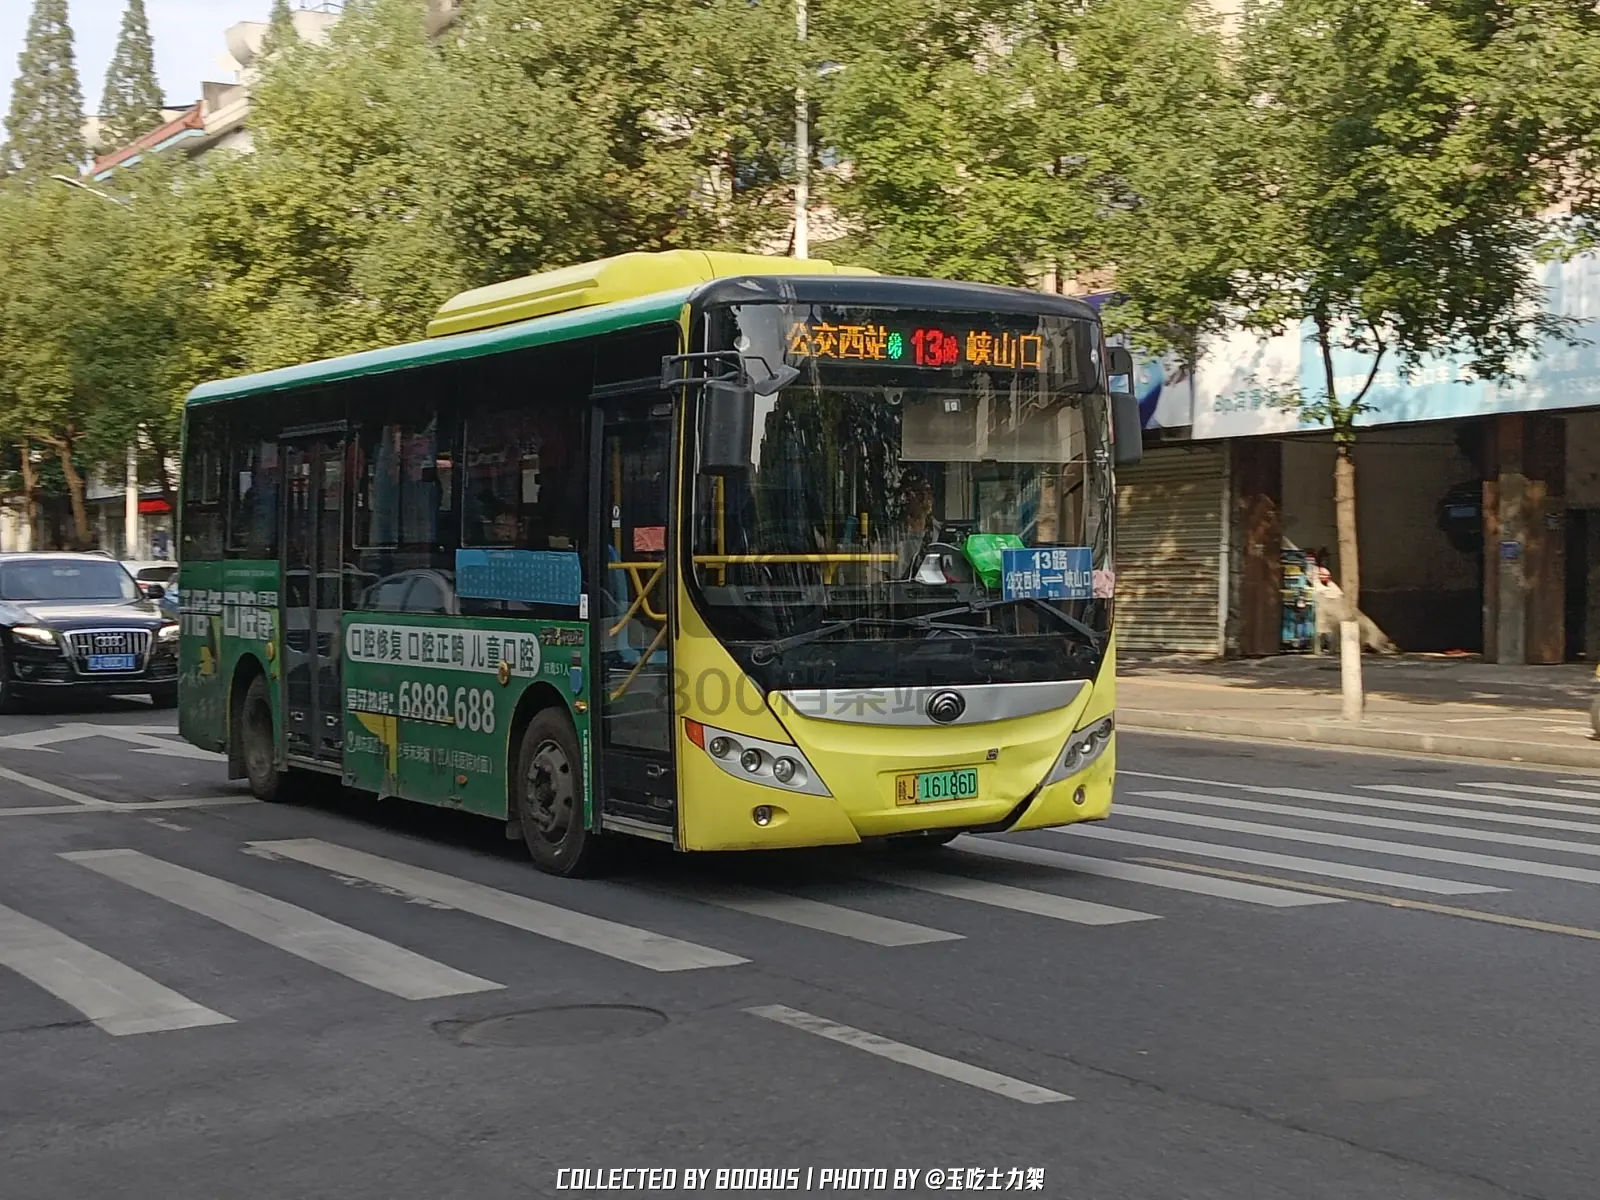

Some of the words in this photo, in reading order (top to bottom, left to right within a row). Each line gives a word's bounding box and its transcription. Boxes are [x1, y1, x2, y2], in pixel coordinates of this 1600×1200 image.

[786, 322, 887, 360] 公交西站
[911, 329, 960, 366] 13路
[965, 330, 1044, 369] 峡山口
[1006, 570, 1041, 590] 公交西站
[1064, 568, 1091, 588] 峡山口
[1031, 550, 1067, 570] 13路
[351, 628, 403, 661] 口腔修复
[408, 631, 465, 667] 口腔正畸
[470, 634, 535, 672] 儿童口腔
[398, 680, 450, 727] 6888
[454, 686, 496, 734] 688
